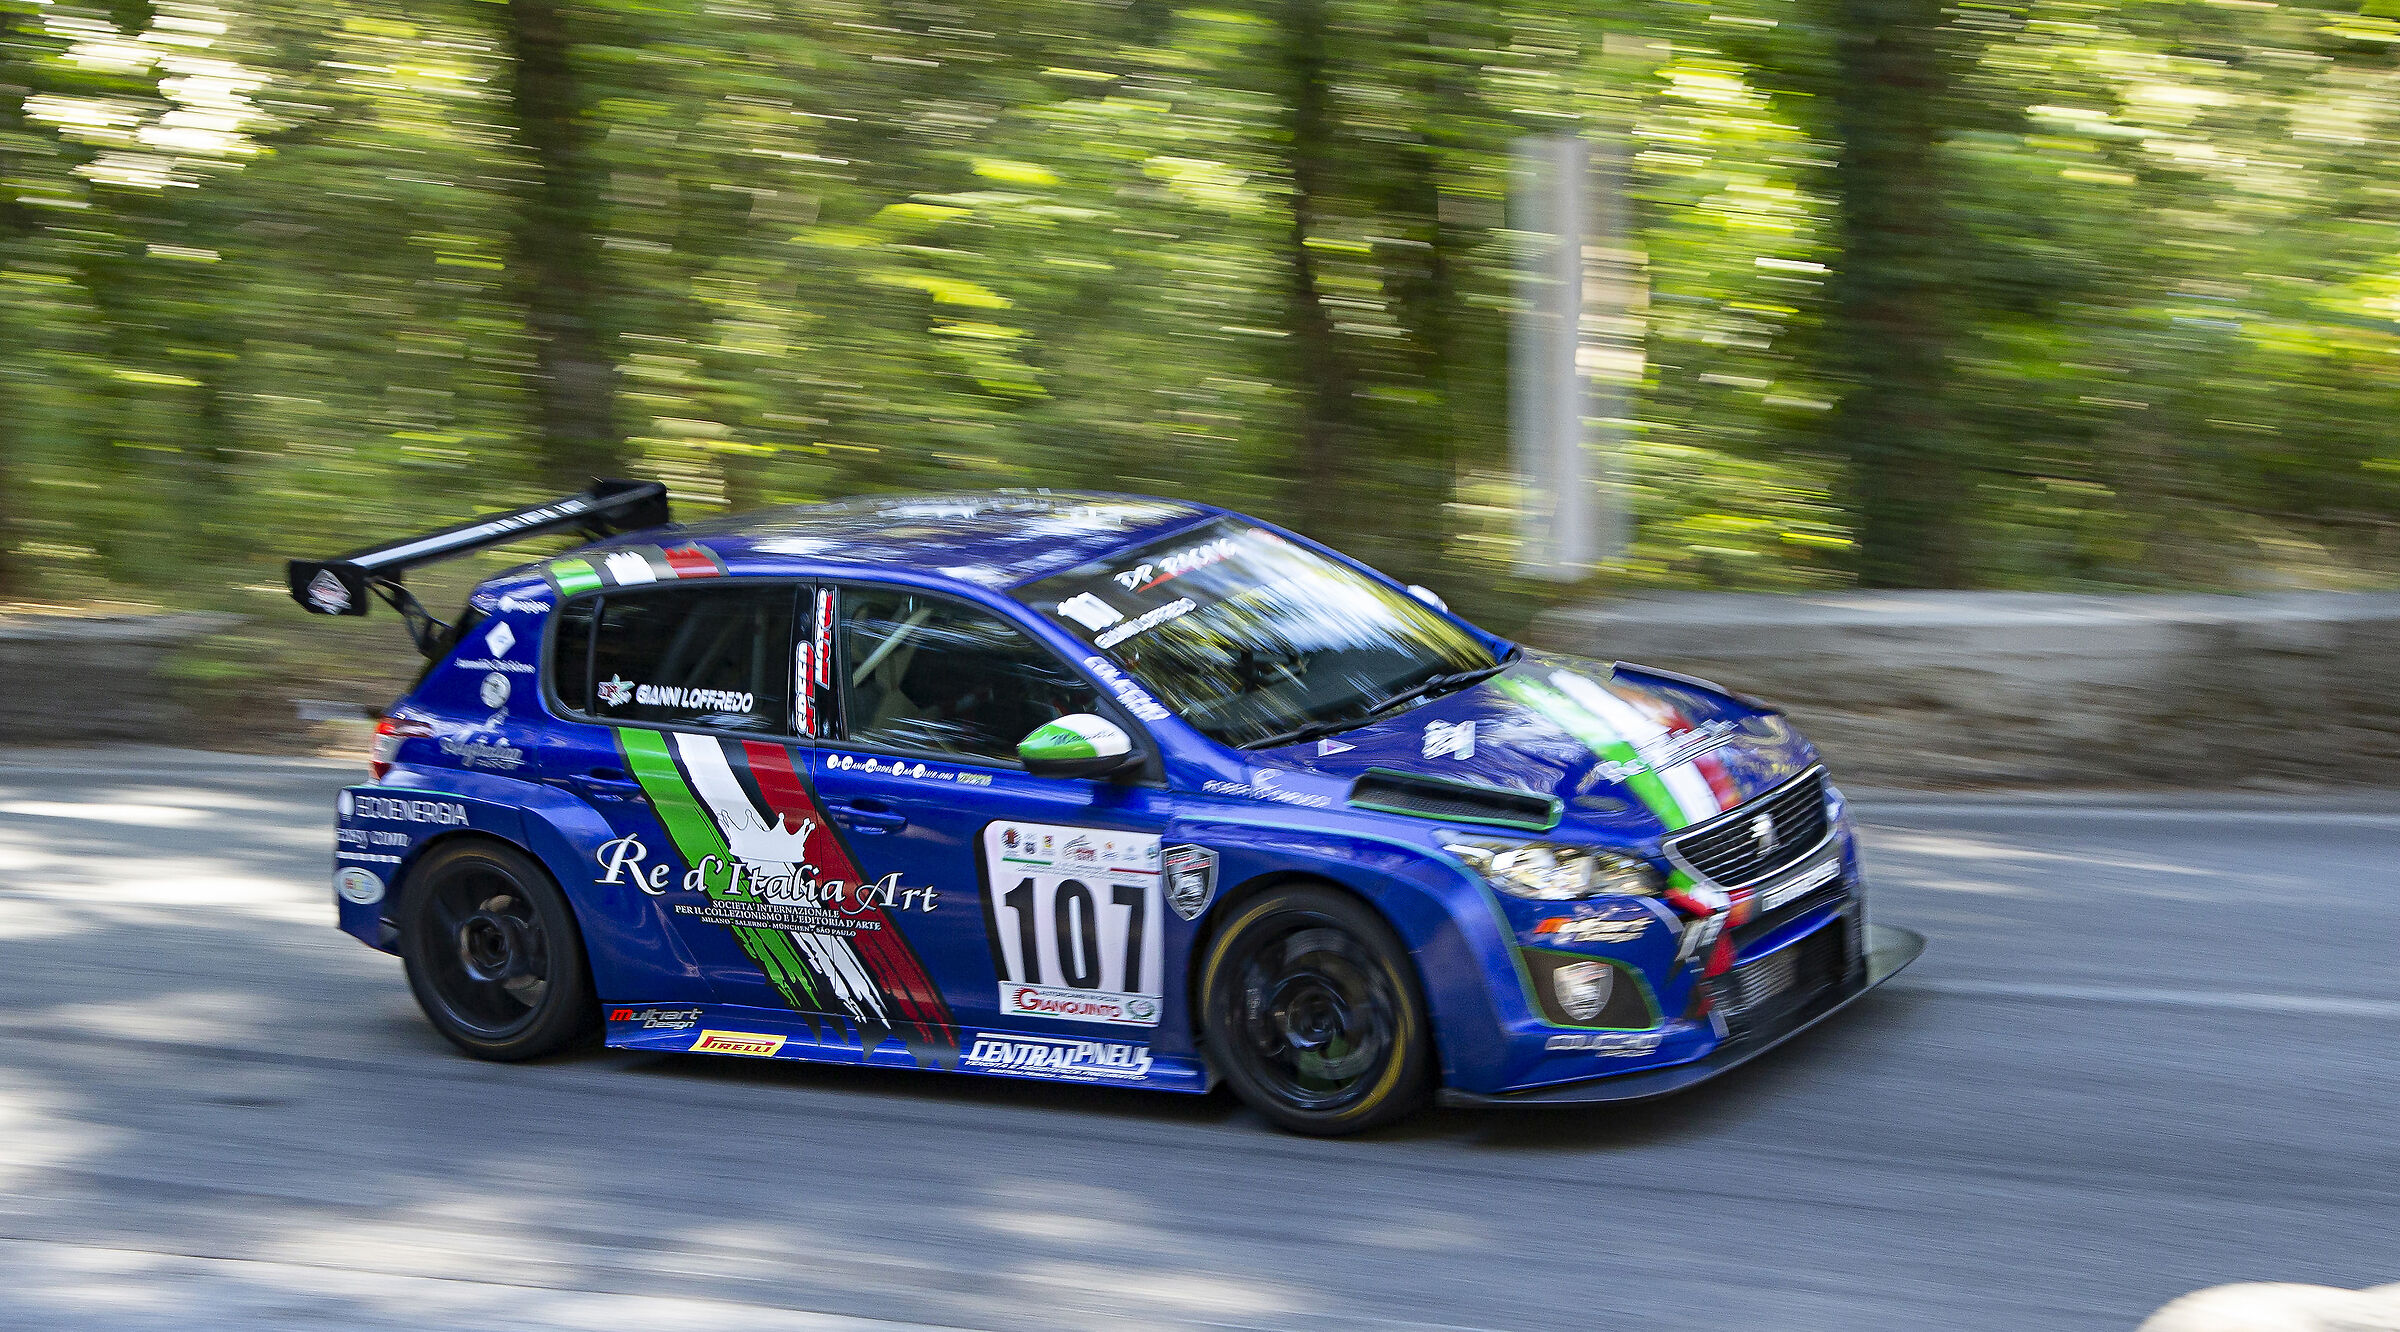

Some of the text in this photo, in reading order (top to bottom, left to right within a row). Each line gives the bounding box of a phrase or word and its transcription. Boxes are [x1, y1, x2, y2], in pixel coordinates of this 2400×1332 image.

[815, 588, 834, 690] MOTOR
[636, 684, 682, 707] GIANNI
[681, 688, 754, 713] LOFFREDO
[795, 640, 815, 739] SPEED
[594, 833, 940, 915] Re d'Italia Art
[675, 905, 692, 914] PER
[705, 908, 782, 921] COLLEZIONISMO
[792, 914, 845, 927] L'EDITORIA
[846, 919, 882, 931] D'ARTE
[756, 904, 840, 919] INTERNAZIONALE
[701, 916, 730, 925] MILANO
[735, 920, 768, 928] SALERNO
[832, 928, 856, 937] PAULO
[1004, 877, 1148, 993] 107
[1014, 987, 1123, 1017] GIANQUINTO
[643, 1019, 695, 1030] Design
[700, 1036, 776, 1053] PIRELLI
